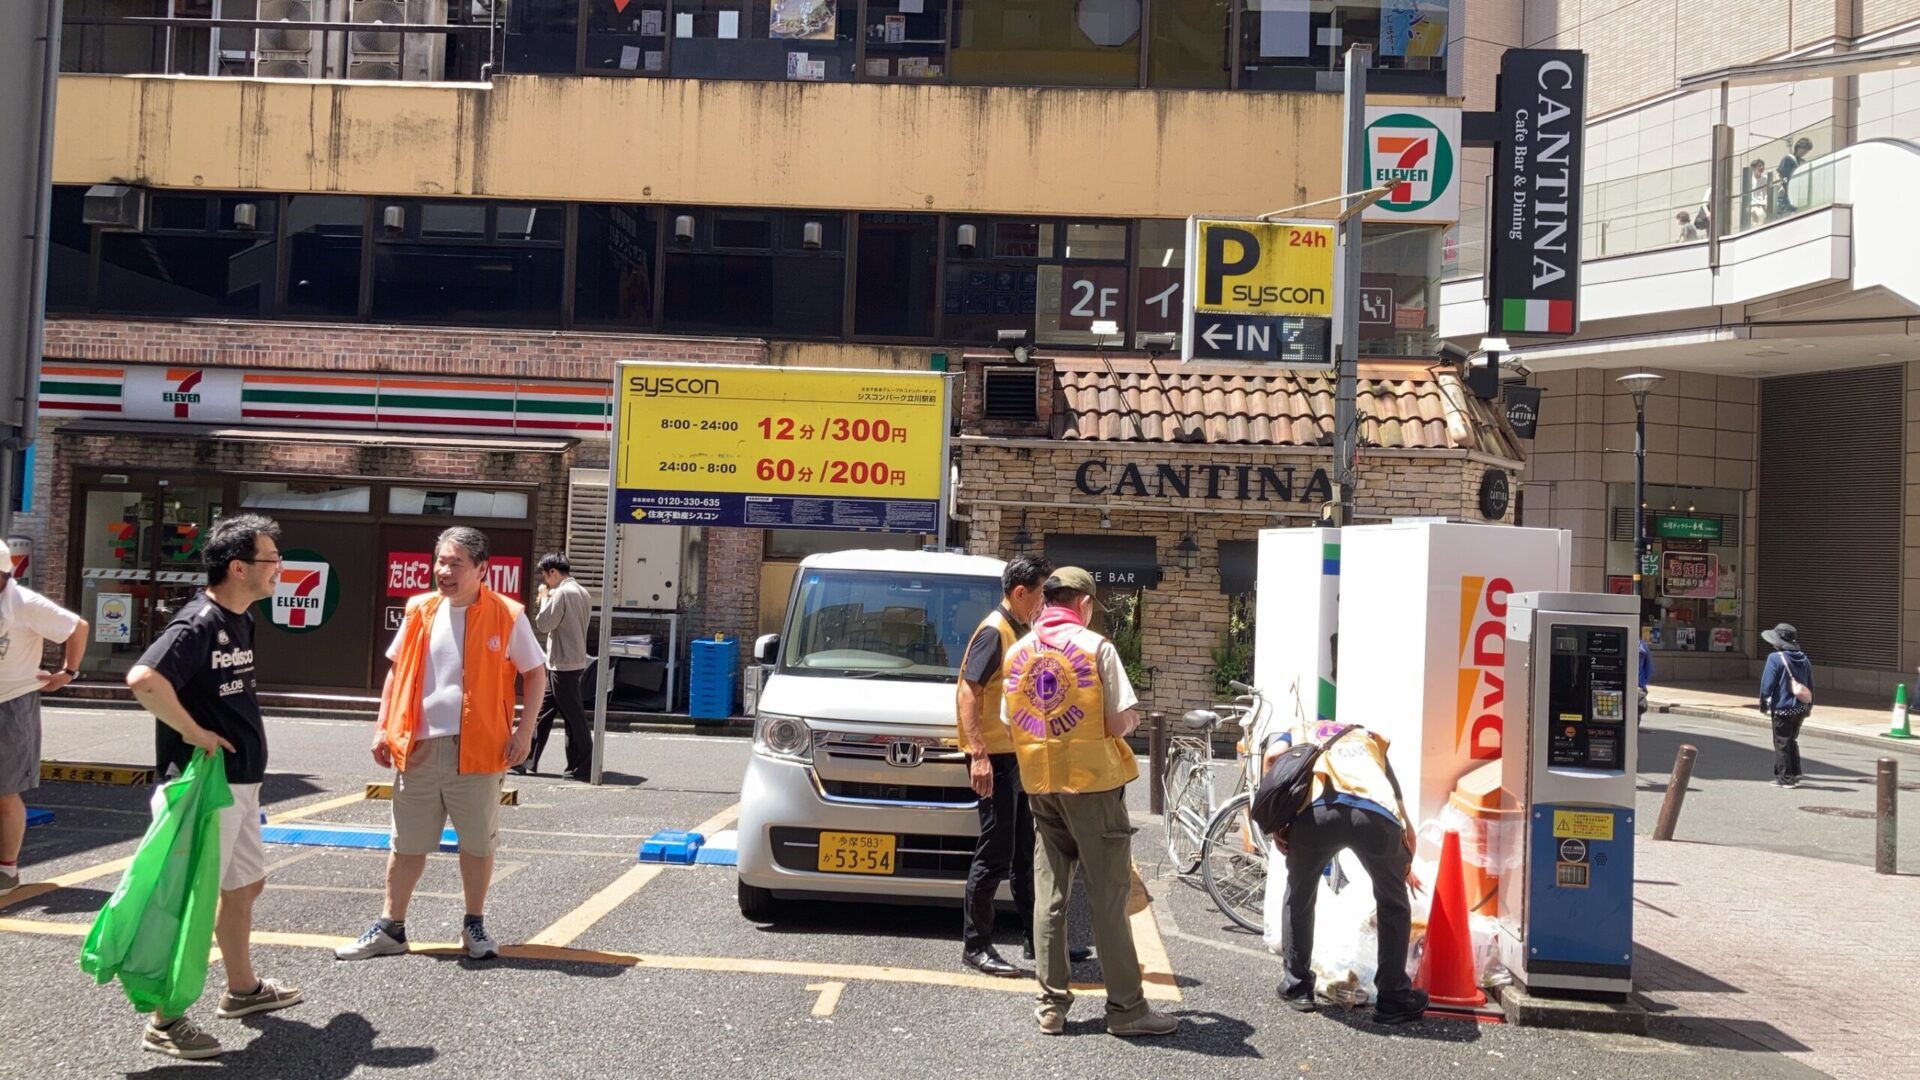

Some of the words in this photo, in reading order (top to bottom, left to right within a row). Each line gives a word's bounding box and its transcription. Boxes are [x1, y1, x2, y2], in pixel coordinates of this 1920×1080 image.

[1514, 109, 1528, 142] Cafe
[1377, 136, 1429, 203] 7
[1514, 146, 1527, 172] Bar
[1513, 175, 1526, 187] &
[1533, 60, 1573, 290] CANTINA
[1509, 191, 1526, 240] Dining
[1289, 231, 1327, 247] 24h
[1204, 227, 1261, 305] P
[1070, 279, 1119, 317] 2F
[1232, 285, 1325, 307] syscon
[1236, 324, 1270, 351] IN
[166, 368, 203, 418] 7
[630, 377, 719, 397] syscon
[1506, 410, 1537, 422] CANTINA
[1075, 459, 1333, 502] CANTINA
[648, 510, 719, 520] 住友不動産シスコン
[657, 497, 720, 507] 0120-330-635
[389, 560, 430, 589] たばこ
[1108, 571, 1135, 583] BAR
[280, 569, 321, 627] 7
[1006, 648, 1029, 693] TOKYO
[1049, 704, 1085, 737] CLUB
[860, 837, 879, 848] 583
[835, 849, 889, 870] 53-54
